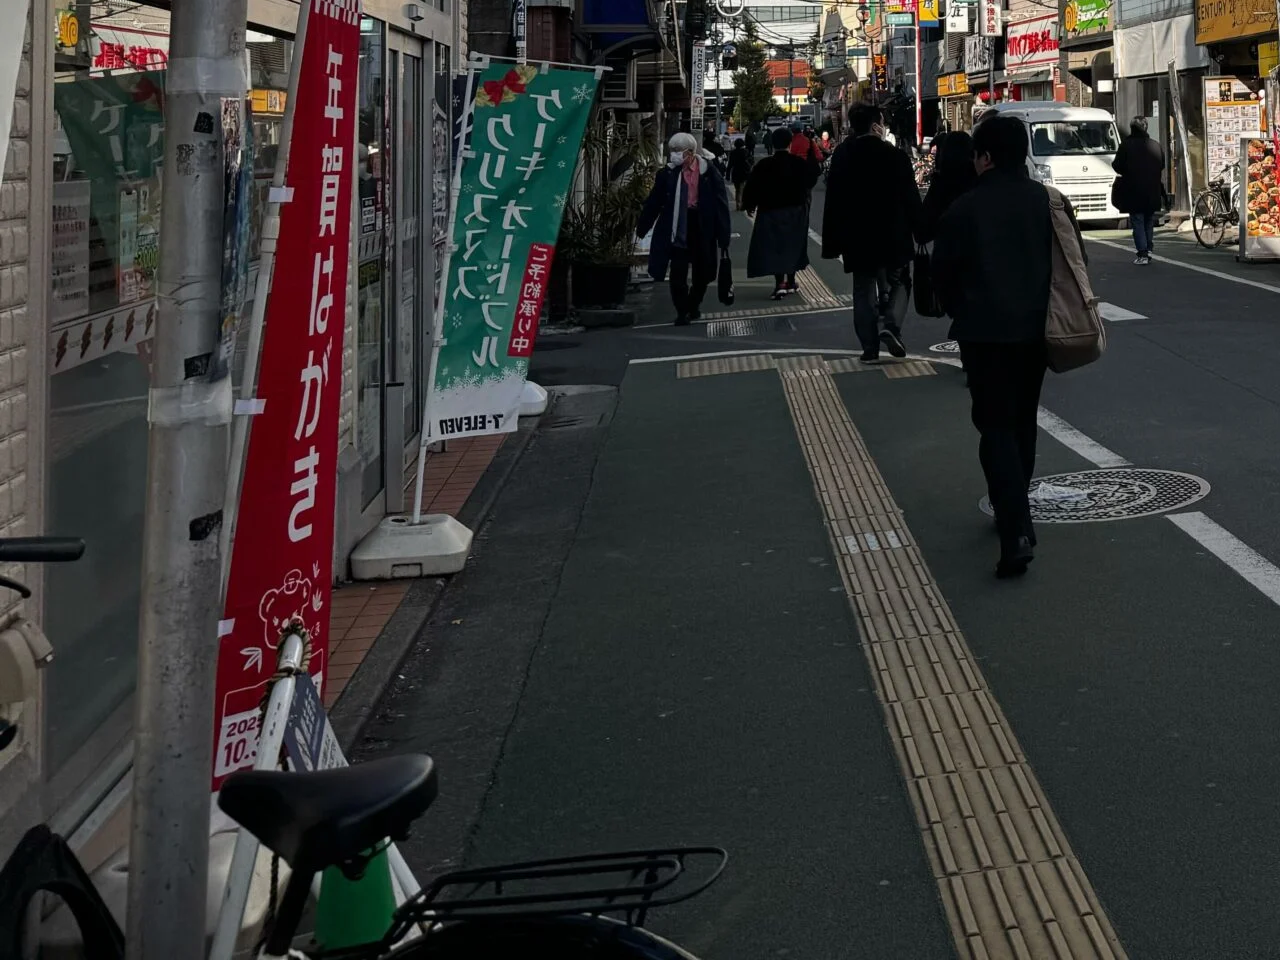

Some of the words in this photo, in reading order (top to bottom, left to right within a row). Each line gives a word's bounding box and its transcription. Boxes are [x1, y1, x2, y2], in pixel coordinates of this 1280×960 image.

[287, 43, 343, 542] 年賀はがき
